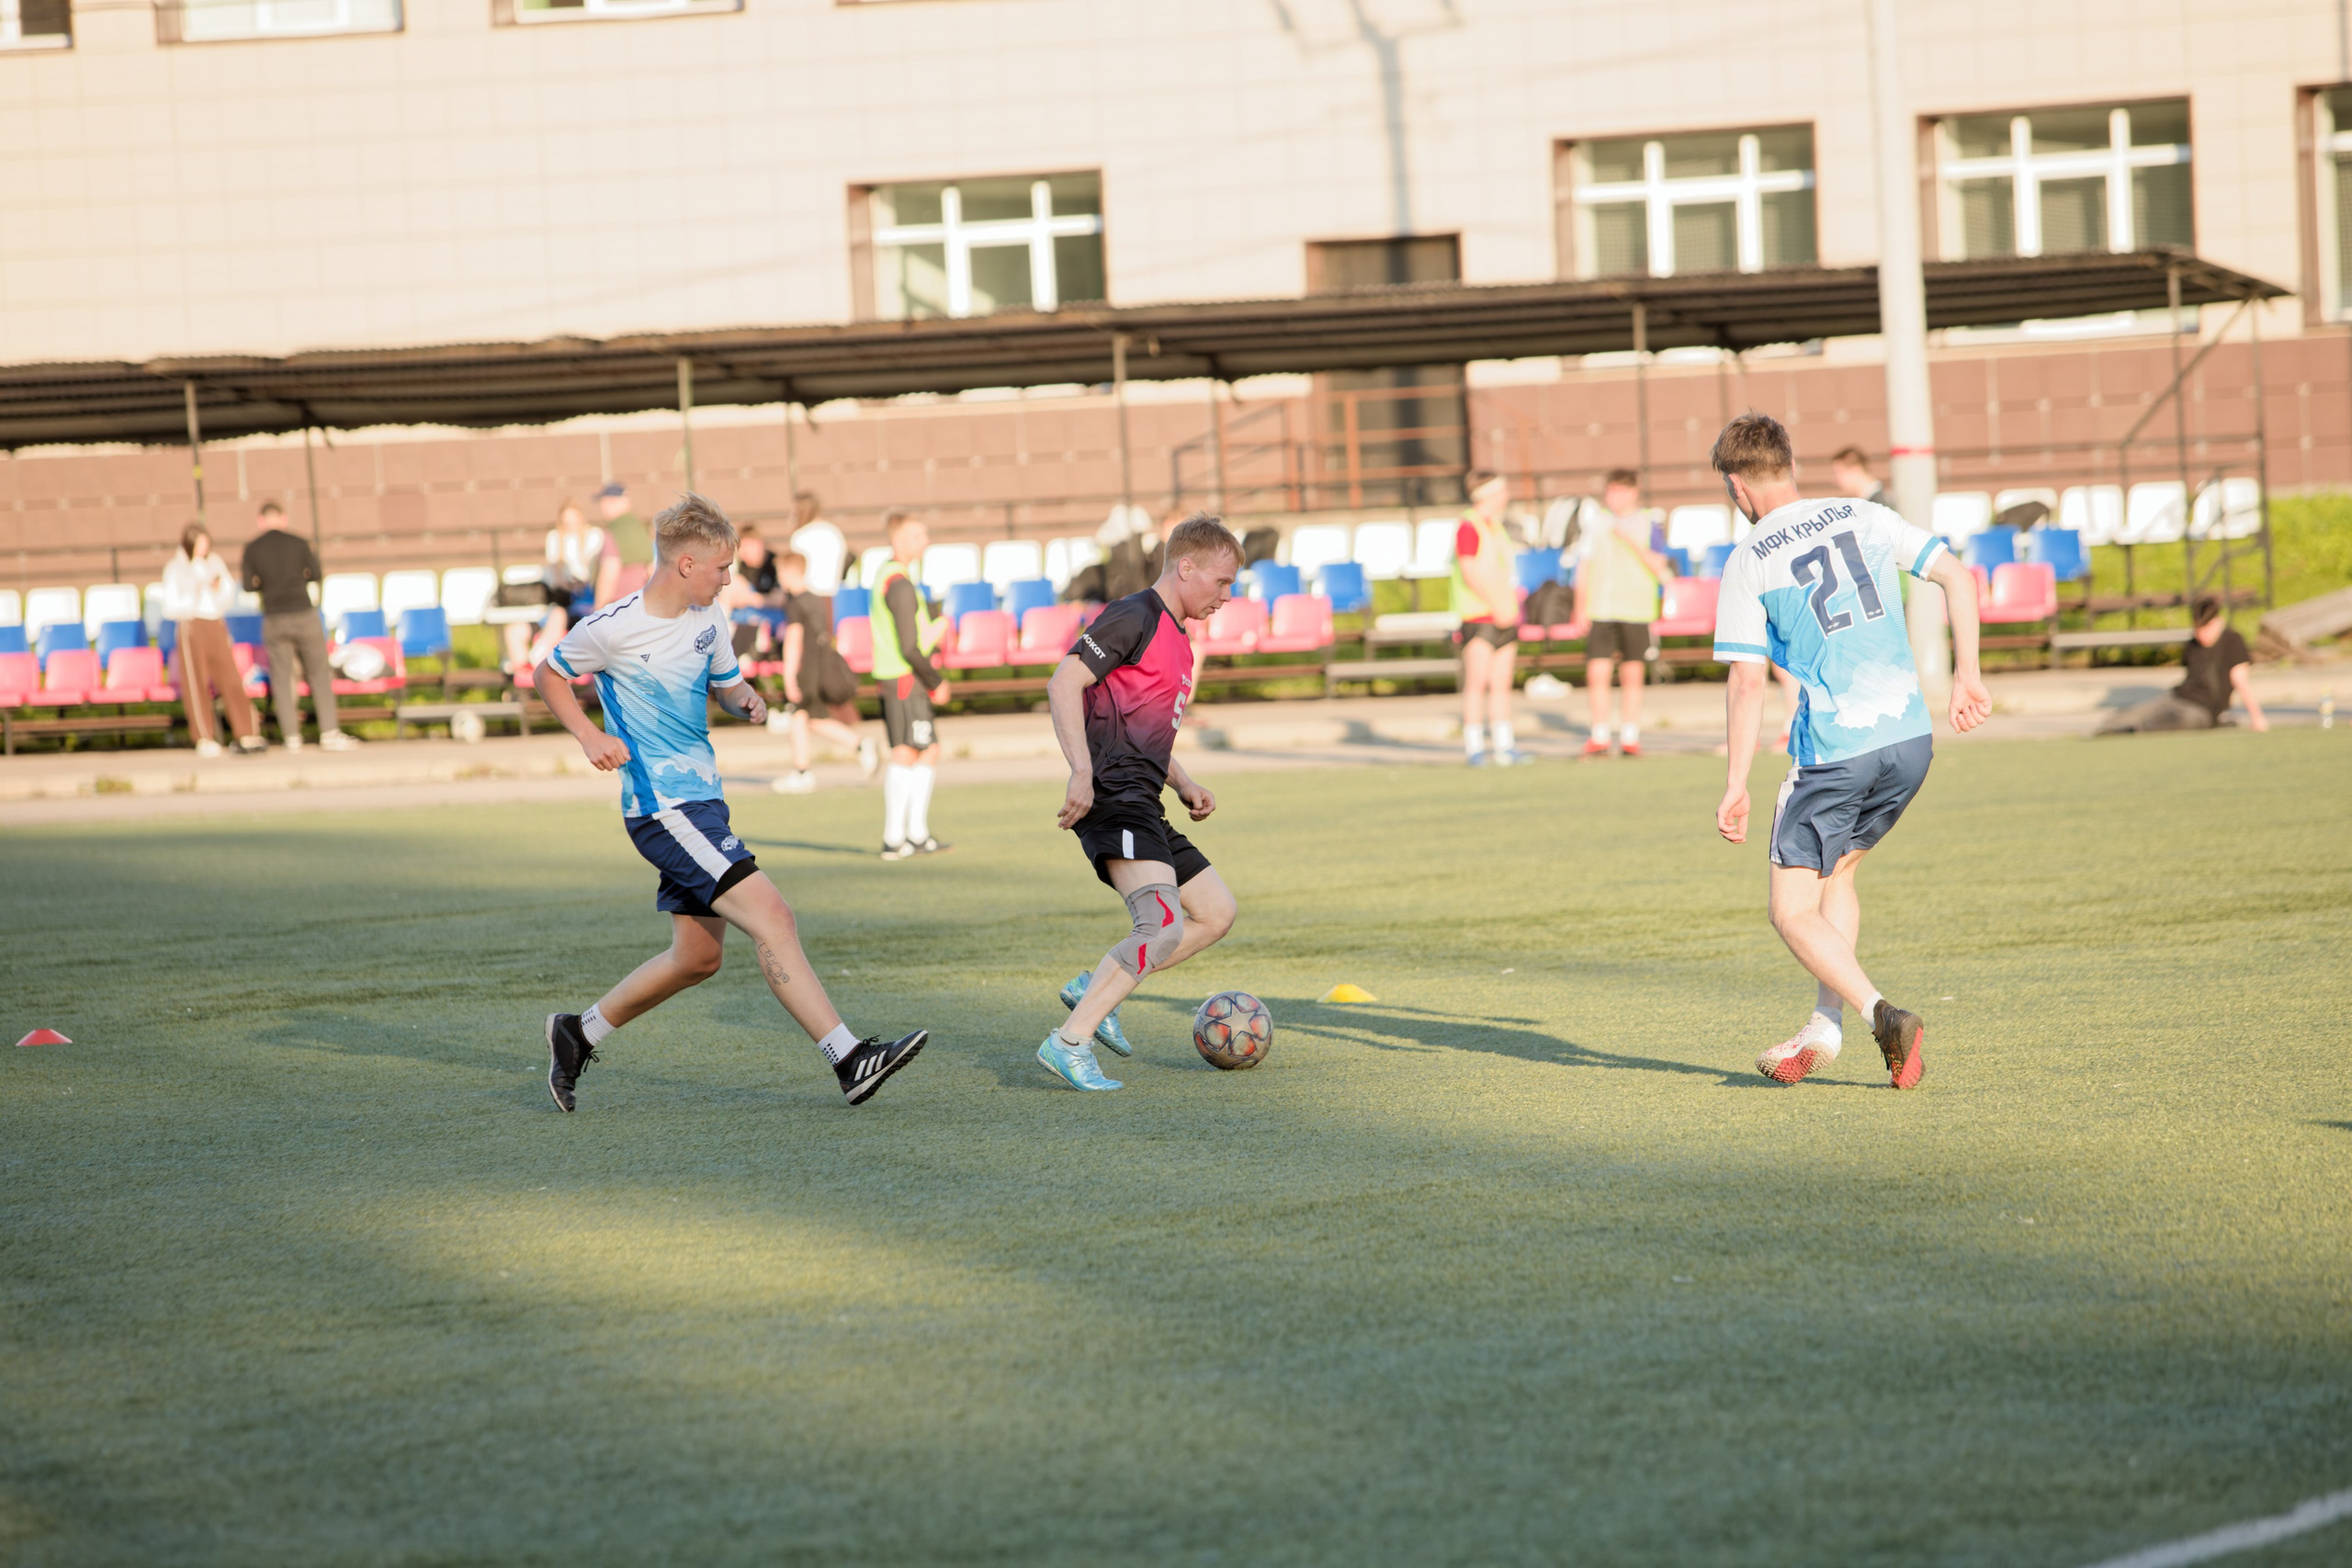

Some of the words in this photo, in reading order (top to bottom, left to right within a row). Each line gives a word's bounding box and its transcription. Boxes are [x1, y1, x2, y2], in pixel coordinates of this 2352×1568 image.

[1751, 528, 1794, 559] МФК
[1791, 505, 1857, 539] КРЫЛЬЯ
[1790, 529, 1885, 639] 21
